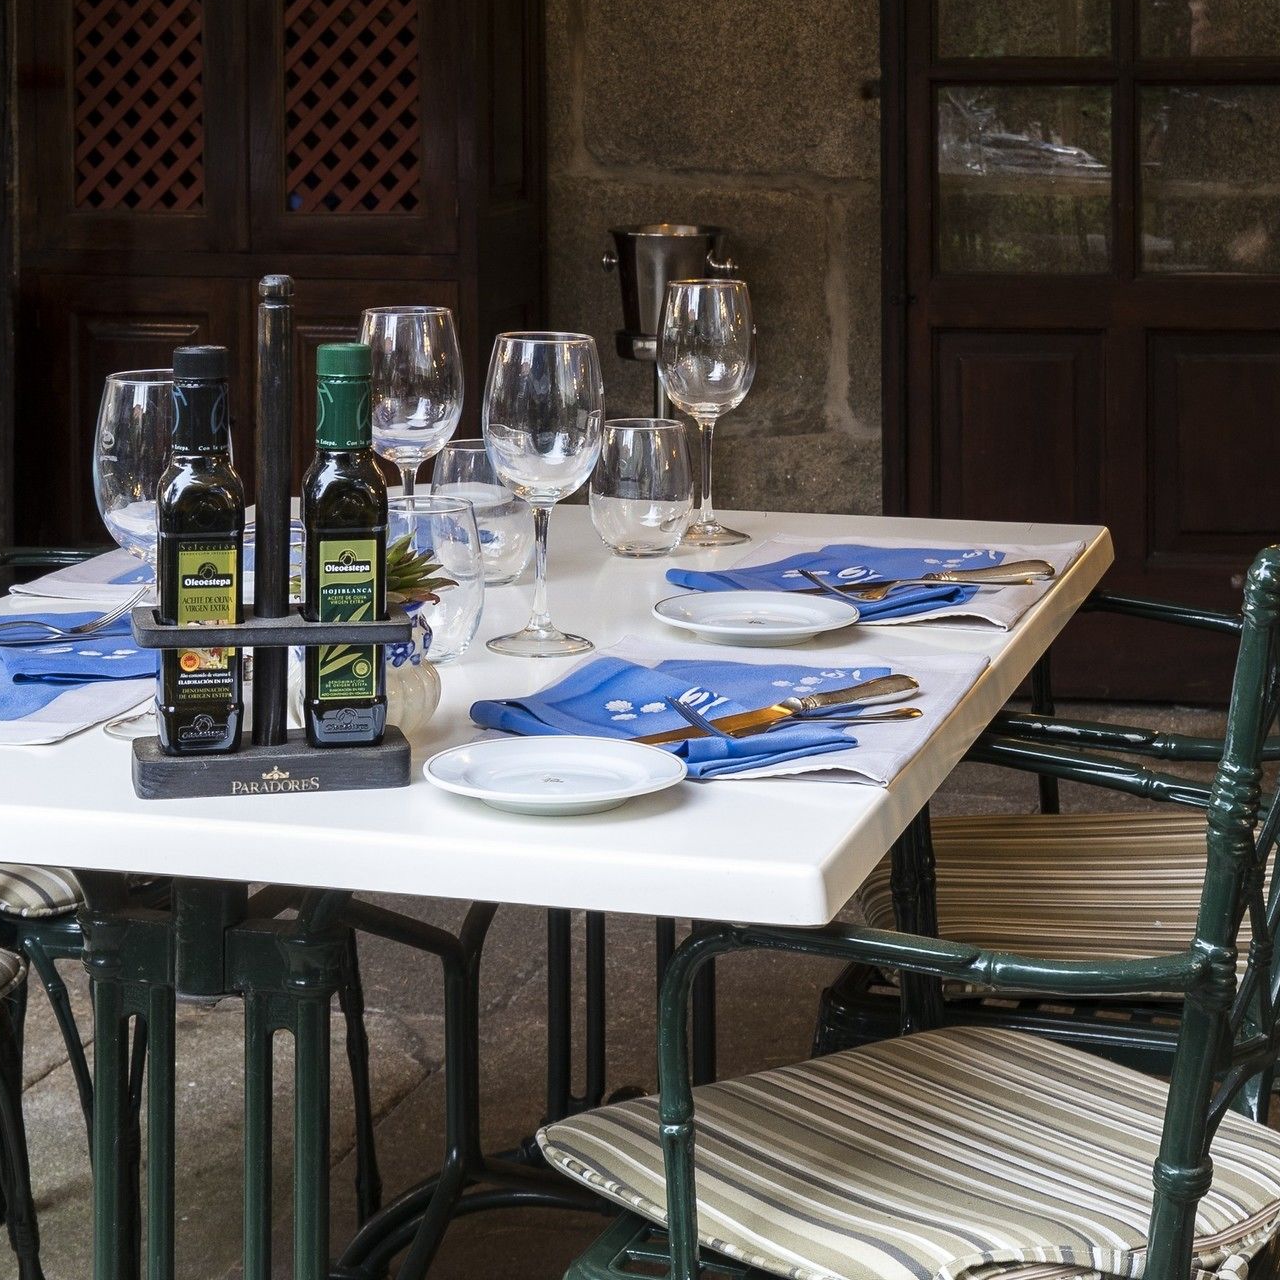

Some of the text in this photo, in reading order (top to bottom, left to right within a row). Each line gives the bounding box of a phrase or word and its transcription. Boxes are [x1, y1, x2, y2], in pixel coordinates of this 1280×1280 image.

[325, 564, 370, 572] Oleoestepa
[184, 578, 231, 587] Oleoestepa
[322, 587, 372, 595] HOJIBLANCA
[205, 596, 214, 604] DE
[185, 604, 230, 612] VIRGEN EXTRA
[231, 777, 319, 794] PARADORES
